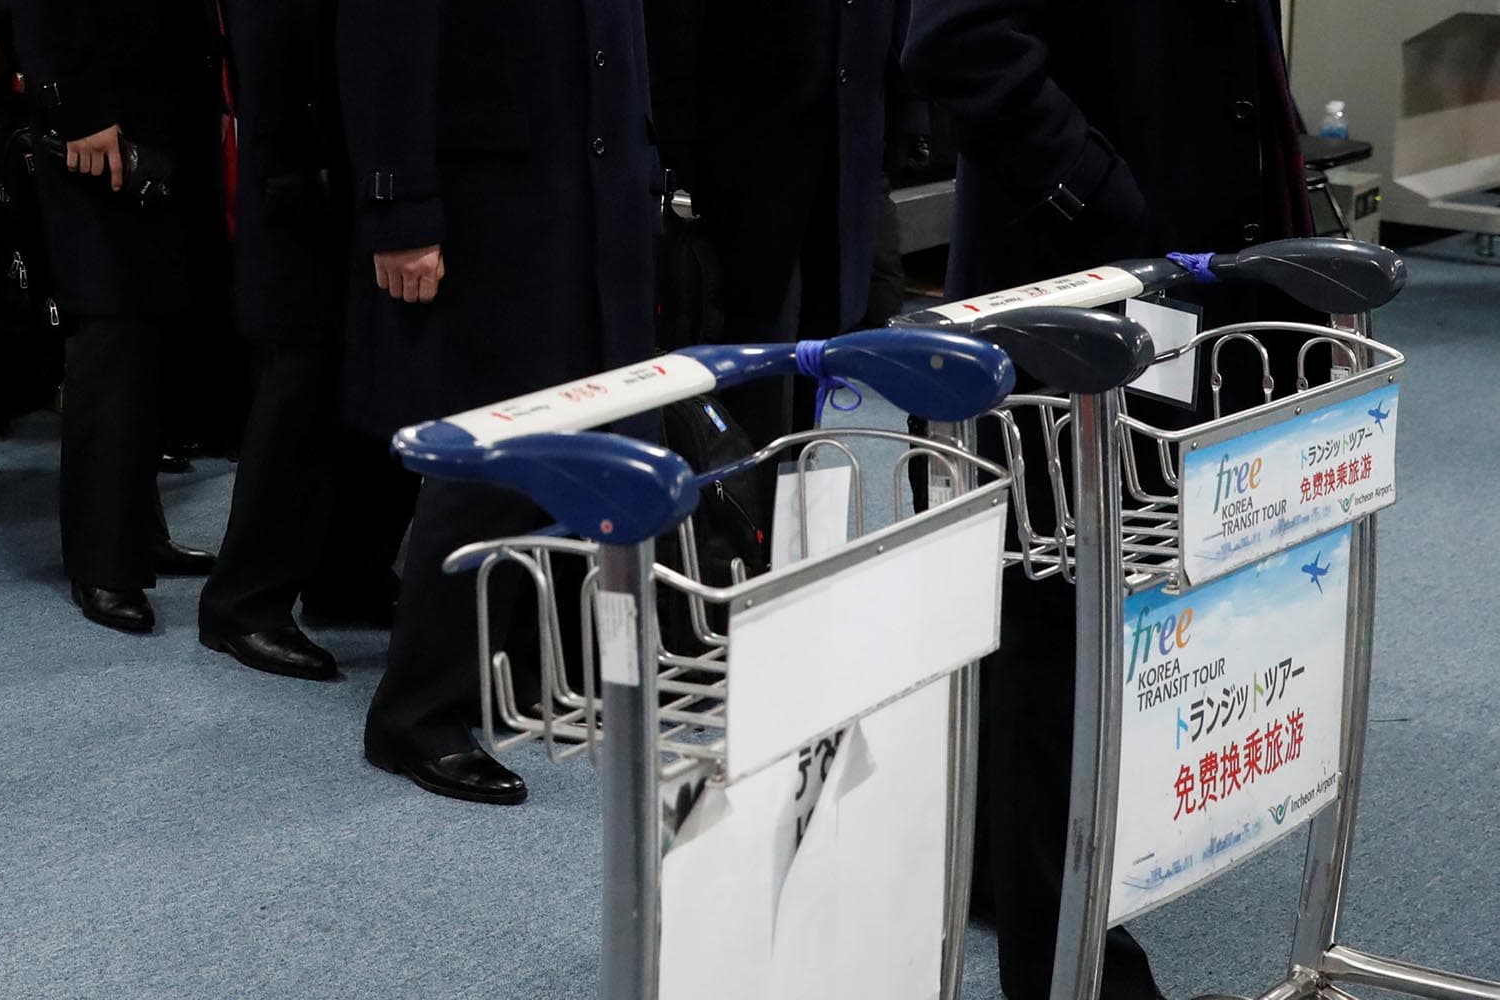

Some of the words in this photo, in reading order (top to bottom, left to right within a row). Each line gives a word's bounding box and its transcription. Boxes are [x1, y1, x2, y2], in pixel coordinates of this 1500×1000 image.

[1301, 427, 1373, 470] トランジットツアー
[1213, 453, 1263, 514] free
[1300, 452, 1373, 504] 免费换乘旅游
[1354, 491, 1374, 506] Incheon
[1375, 484, 1393, 498] Airport
[1221, 496, 1253, 520] KOREA
[1221, 507, 1260, 537] TRANSIT
[1261, 499, 1287, 521] TOUR
[1126, 605, 1193, 684] free
[1137, 671, 1191, 712] TRANSIT
[1192, 656, 1226, 688] TOUR
[1138, 657, 1181, 691] KOREA
[1176, 657, 1306, 750] トランジットツアー
[1173, 707, 1305, 821] 免费换乘旅游
[1290, 788, 1315, 813] Incheon
[1315, 772, 1337, 797] Airport
